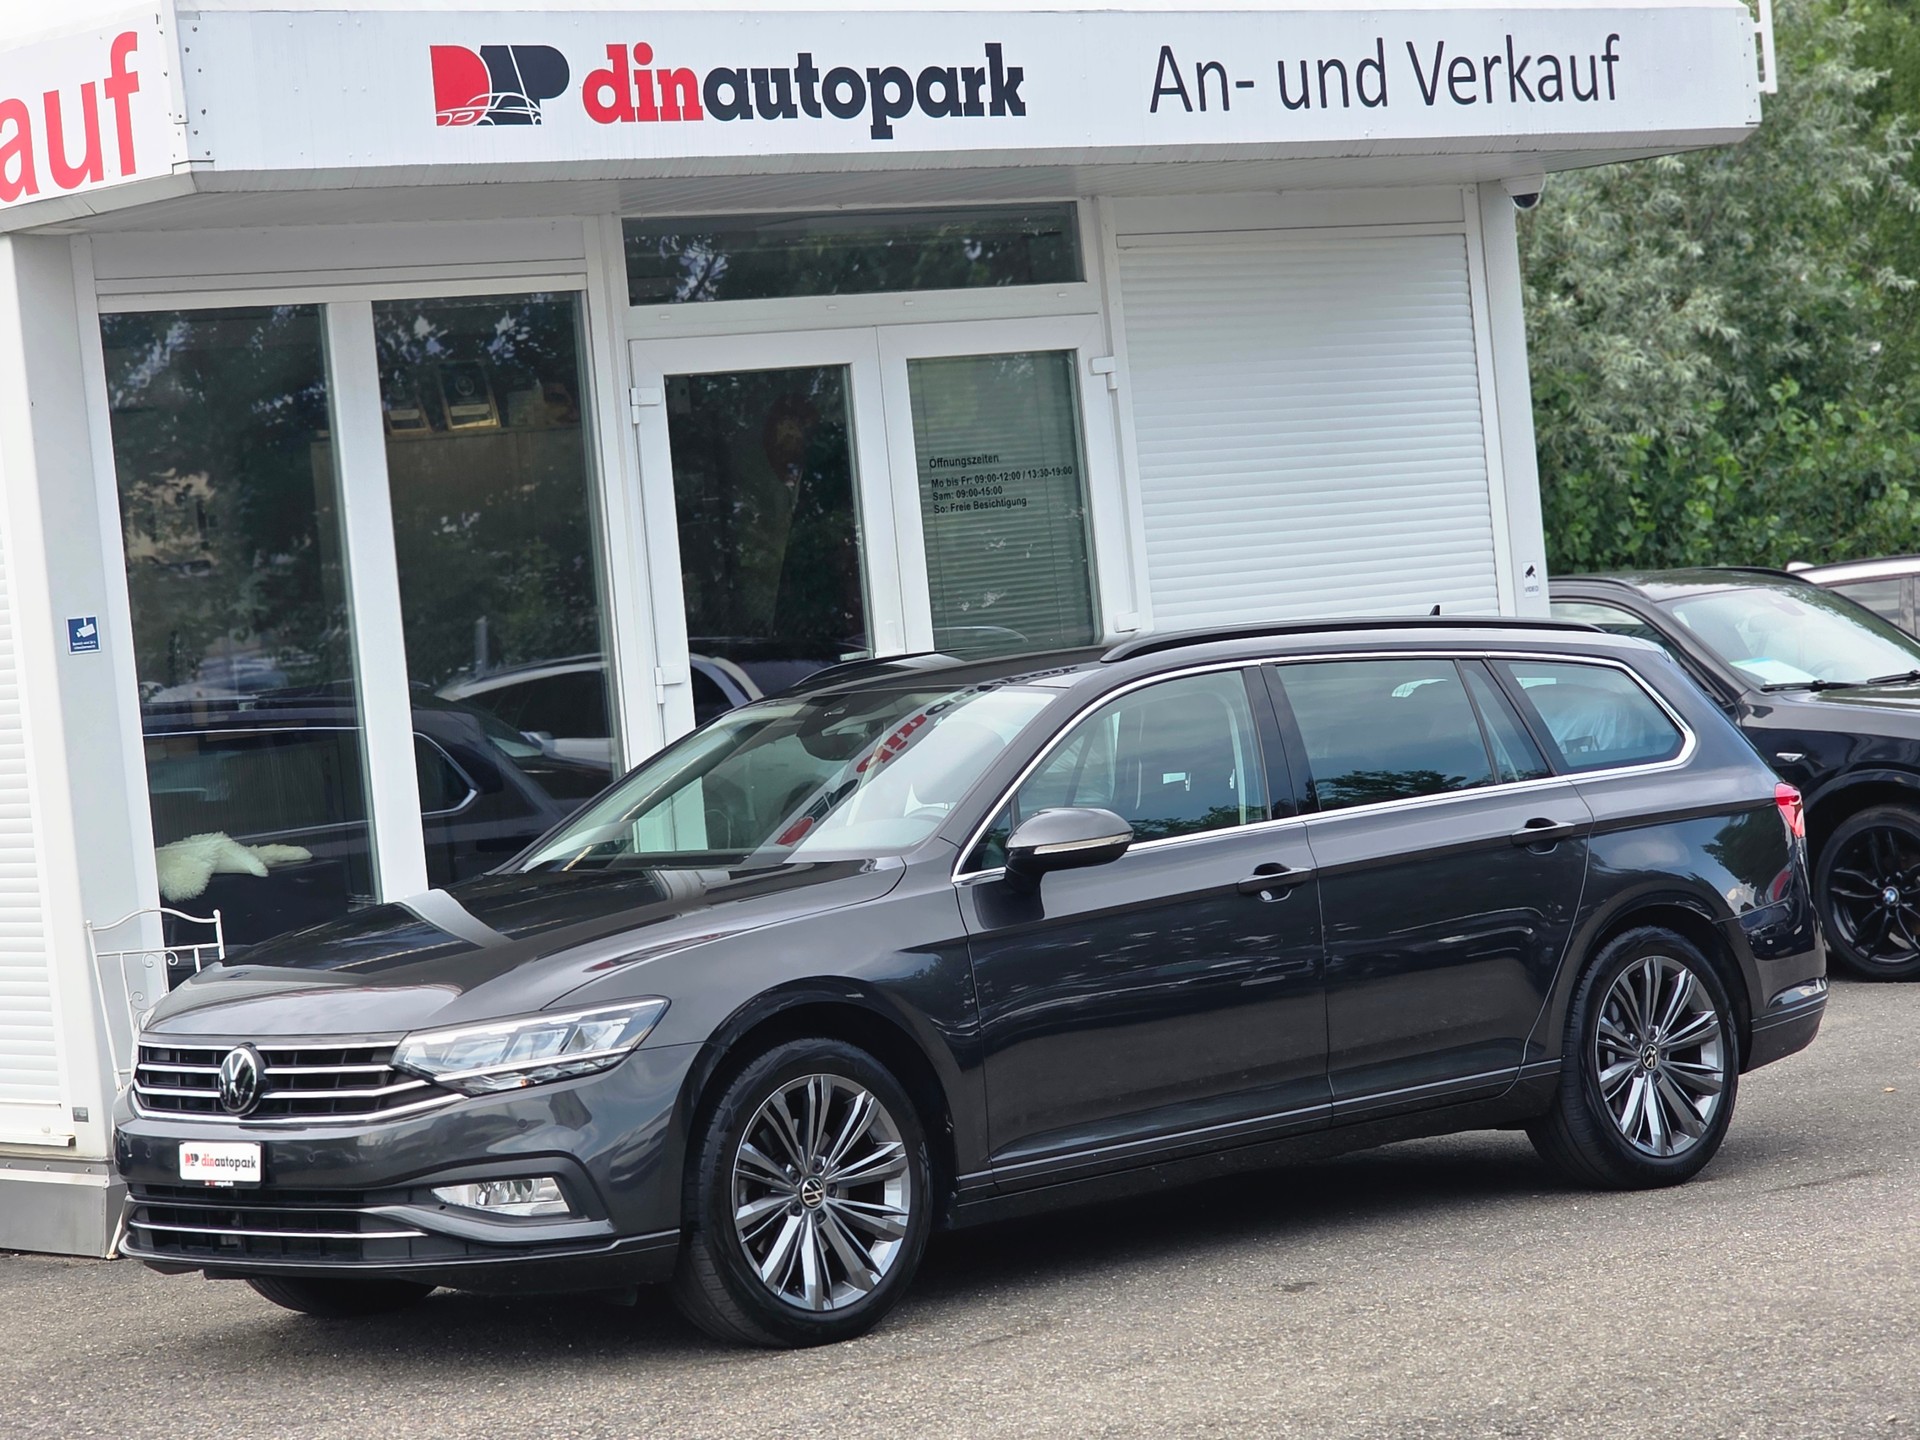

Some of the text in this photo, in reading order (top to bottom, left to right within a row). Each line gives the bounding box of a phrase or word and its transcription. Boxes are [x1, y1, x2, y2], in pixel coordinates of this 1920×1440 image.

[1150, 33, 1621, 113] An- und Verkauf
[582, 42, 1026, 140] dinautopark
[929, 454, 999, 469] Öffnungszeiten
[931, 478, 944, 488] Mo
[946, 476, 959, 487] bis
[961, 475, 973, 486] Fr:
[974, 470, 1021, 485] 09:00-12:00
[1027, 465, 1073, 480] 13:30-19:00
[932, 485, 1003, 502] Sam: 09:00-15:00
[934, 497, 1027, 514] So: Freie Besichtigung
[201, 1153, 256, 1172] dinautopark
